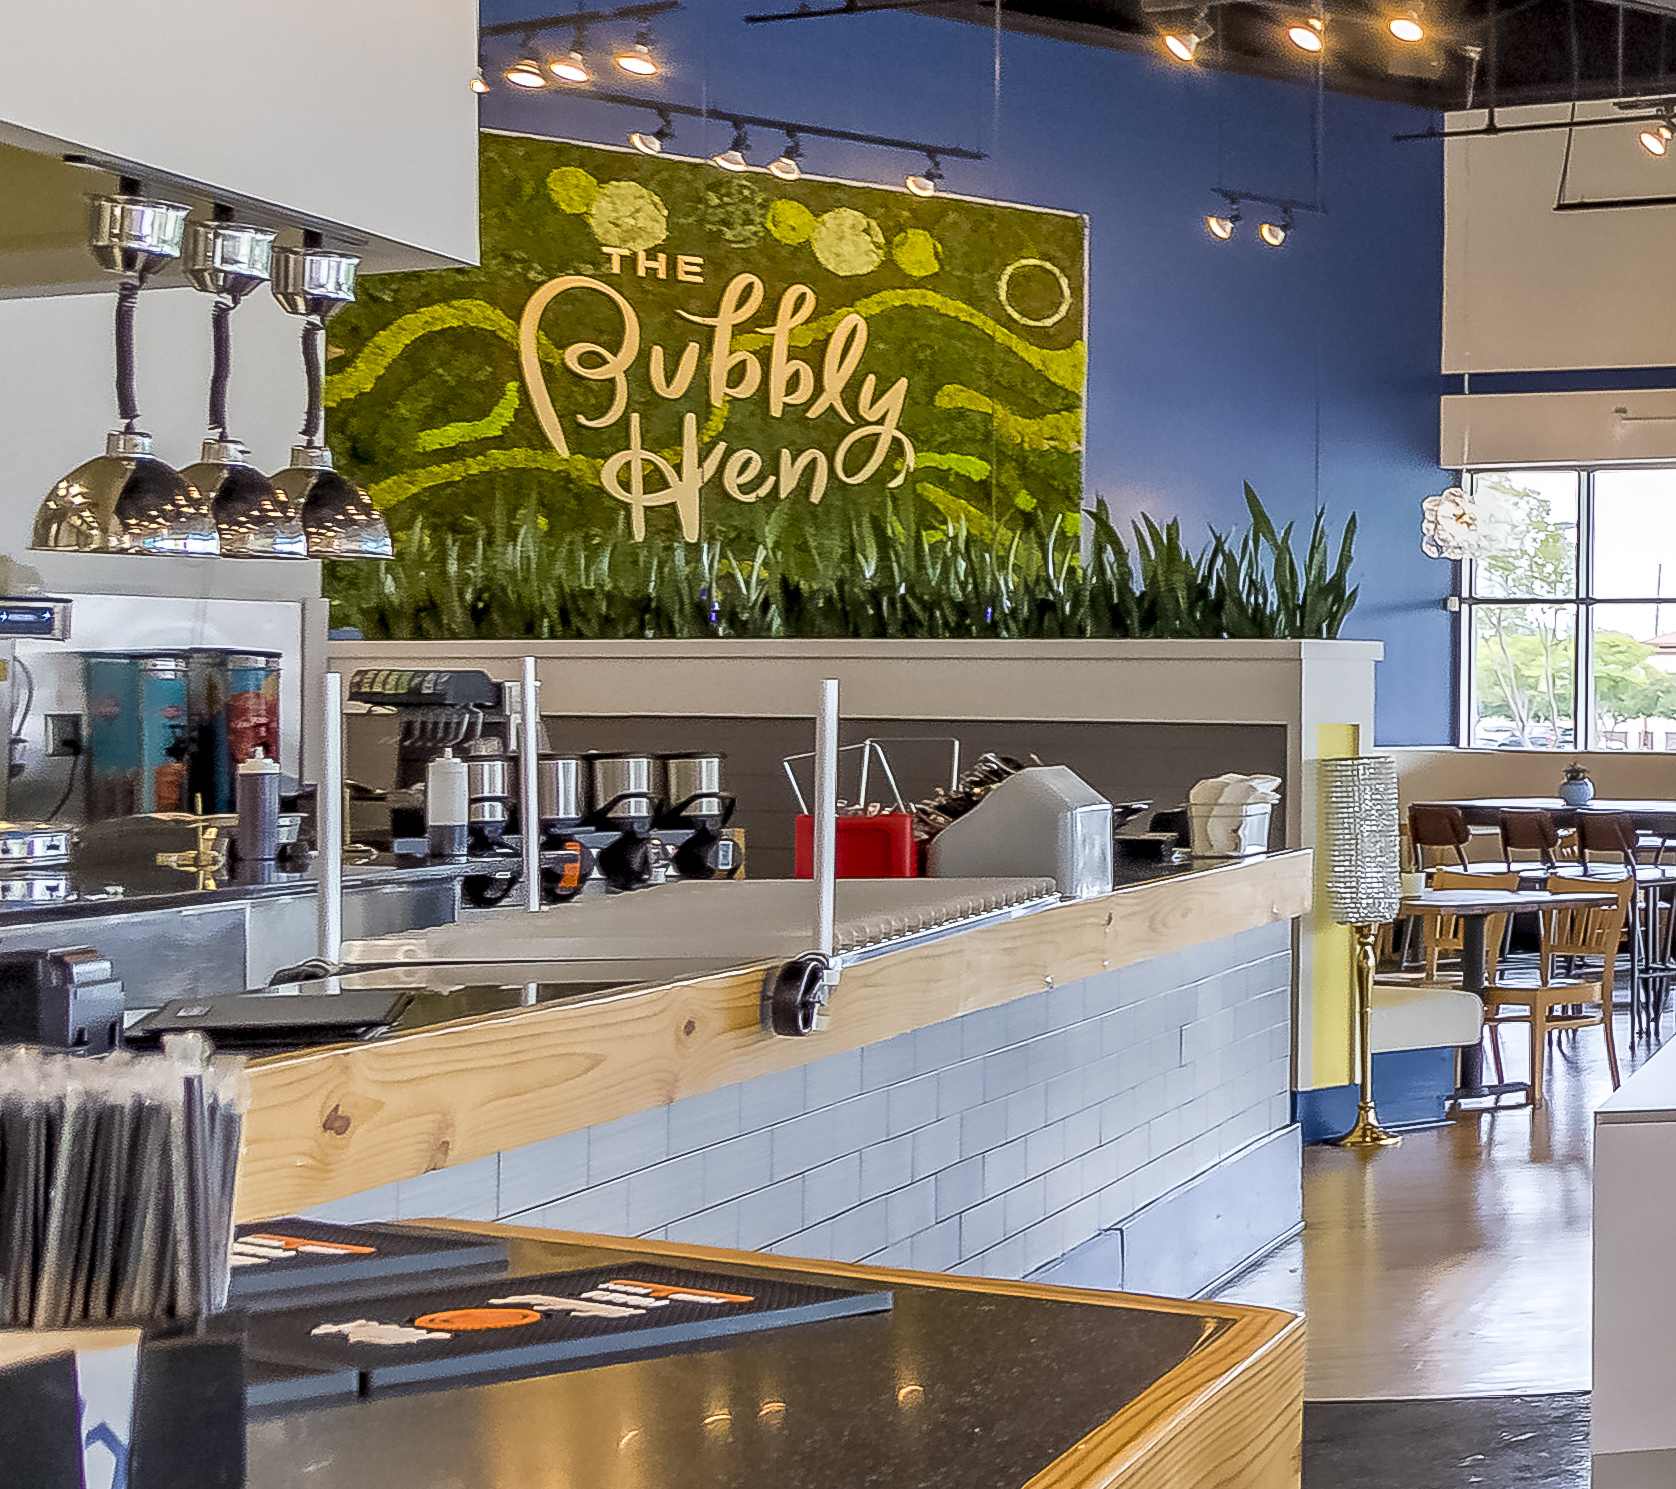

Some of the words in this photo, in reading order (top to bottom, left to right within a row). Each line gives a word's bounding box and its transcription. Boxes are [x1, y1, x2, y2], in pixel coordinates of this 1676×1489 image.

[600, 247, 705, 284] THE
[518, 272, 916, 490] Bubbly
[600, 412, 828, 543] Hen
